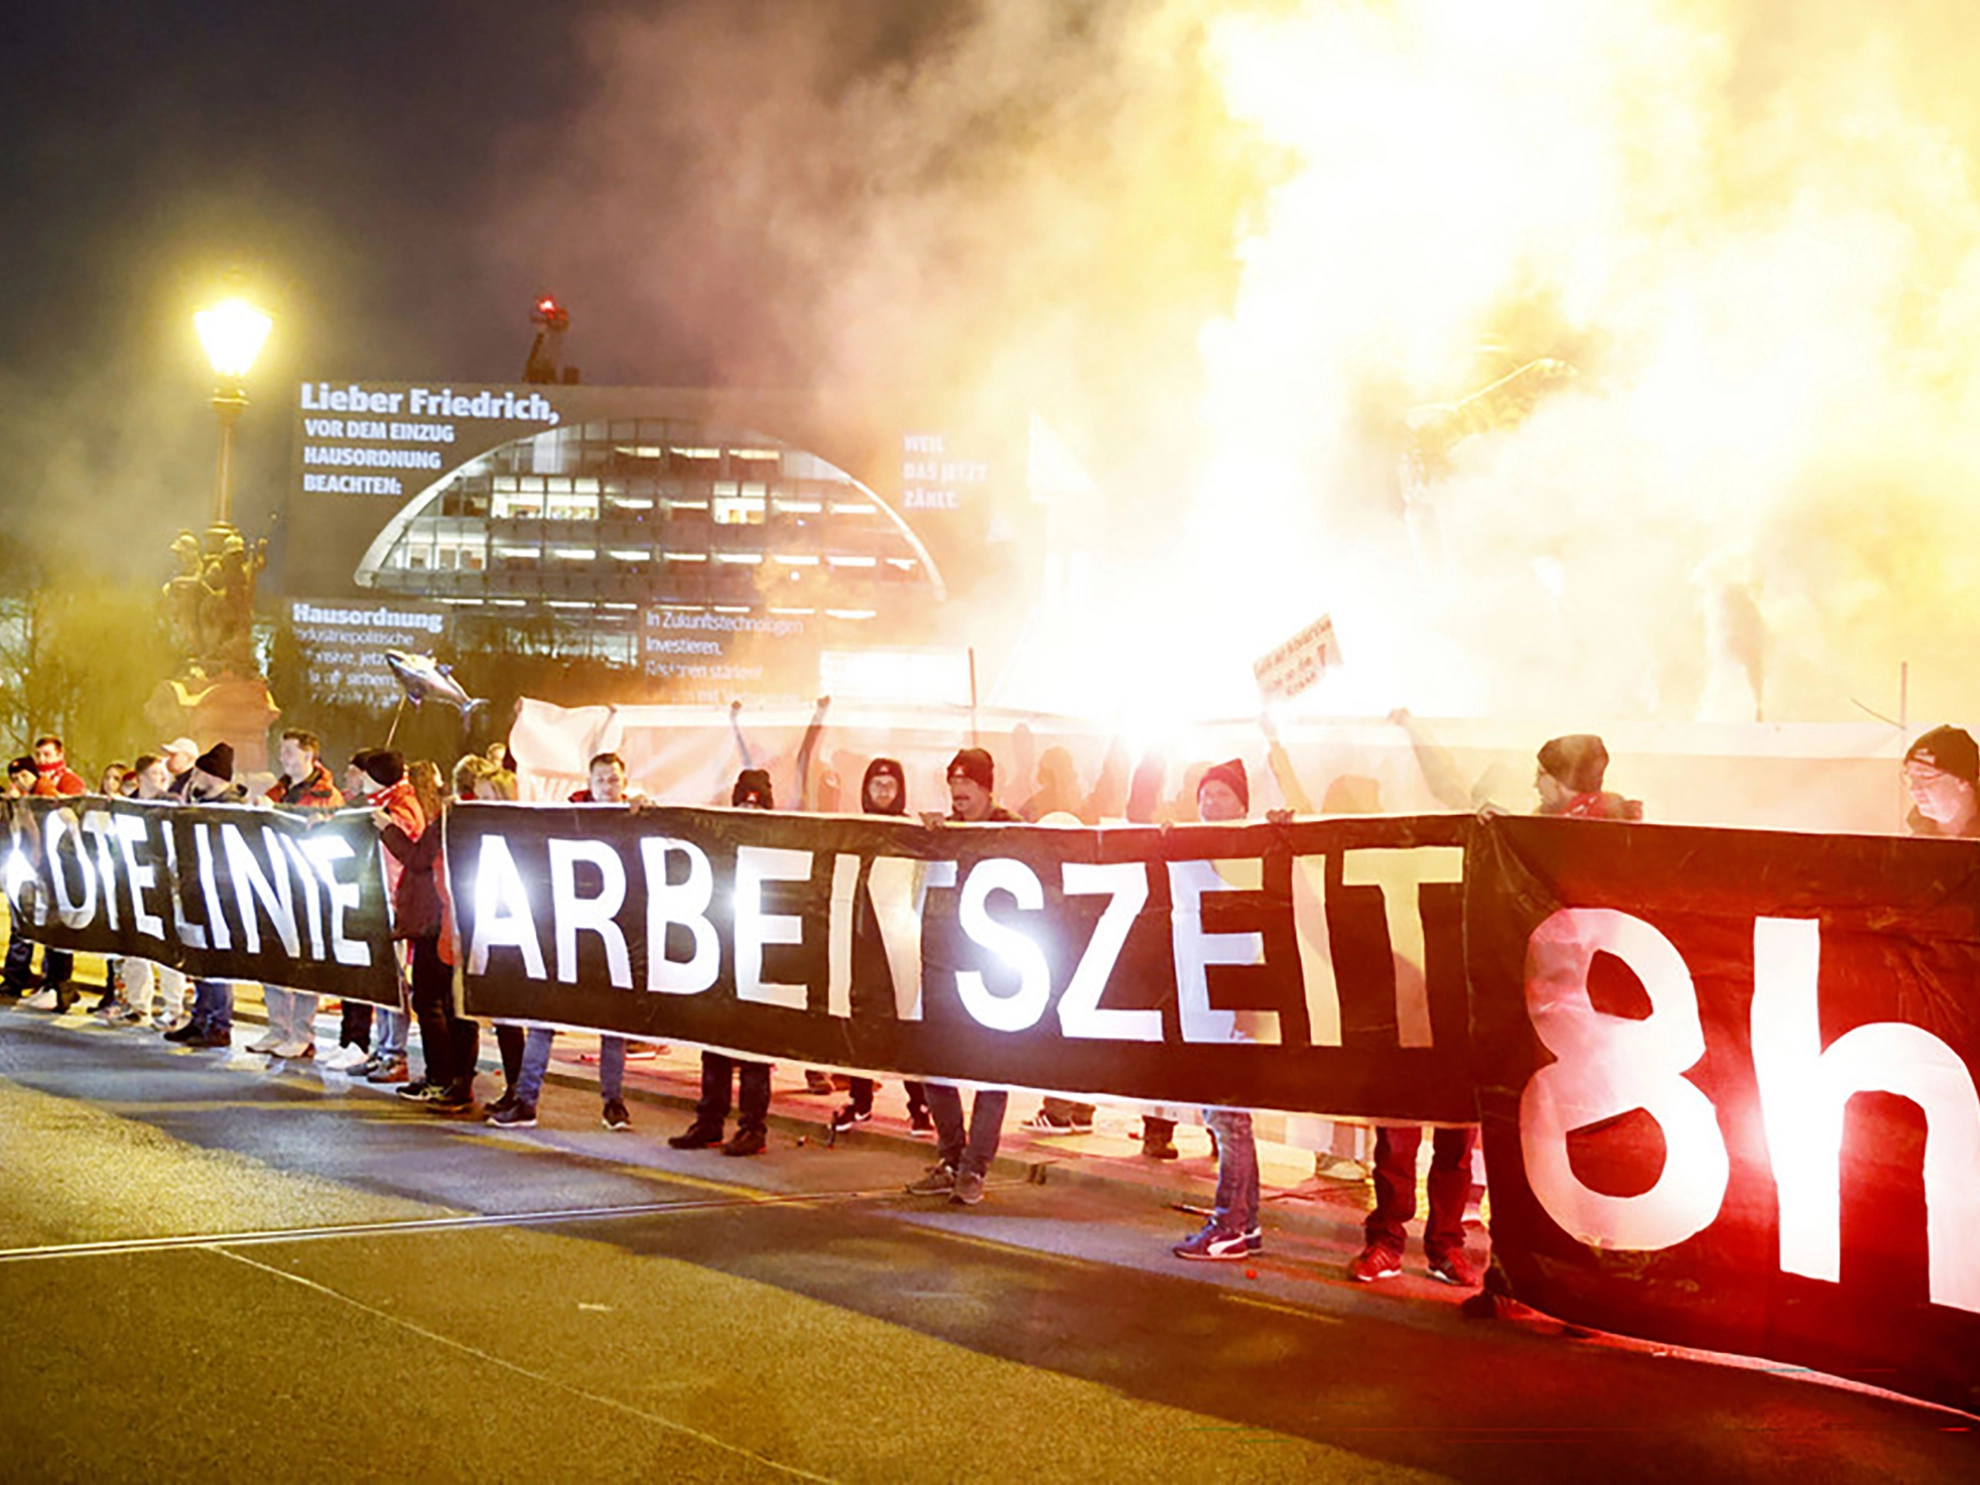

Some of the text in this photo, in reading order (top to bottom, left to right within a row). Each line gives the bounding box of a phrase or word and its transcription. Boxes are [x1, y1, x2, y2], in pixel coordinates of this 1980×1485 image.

[301, 382, 560, 425] Lieber Friedrich,
[304, 419, 455, 442] VOR DEM EINZUG
[304, 446, 441, 469] HAUSORDNUNG
[303, 473, 402, 495] BEACHTEN:
[292, 603, 443, 633] Hausordnung
[646, 611, 660, 627] In
[162, 819, 372, 967] LINIE
[467, 834, 1464, 1048] ARBEITSZEIT
[1519, 907, 1980, 1314] 8h
